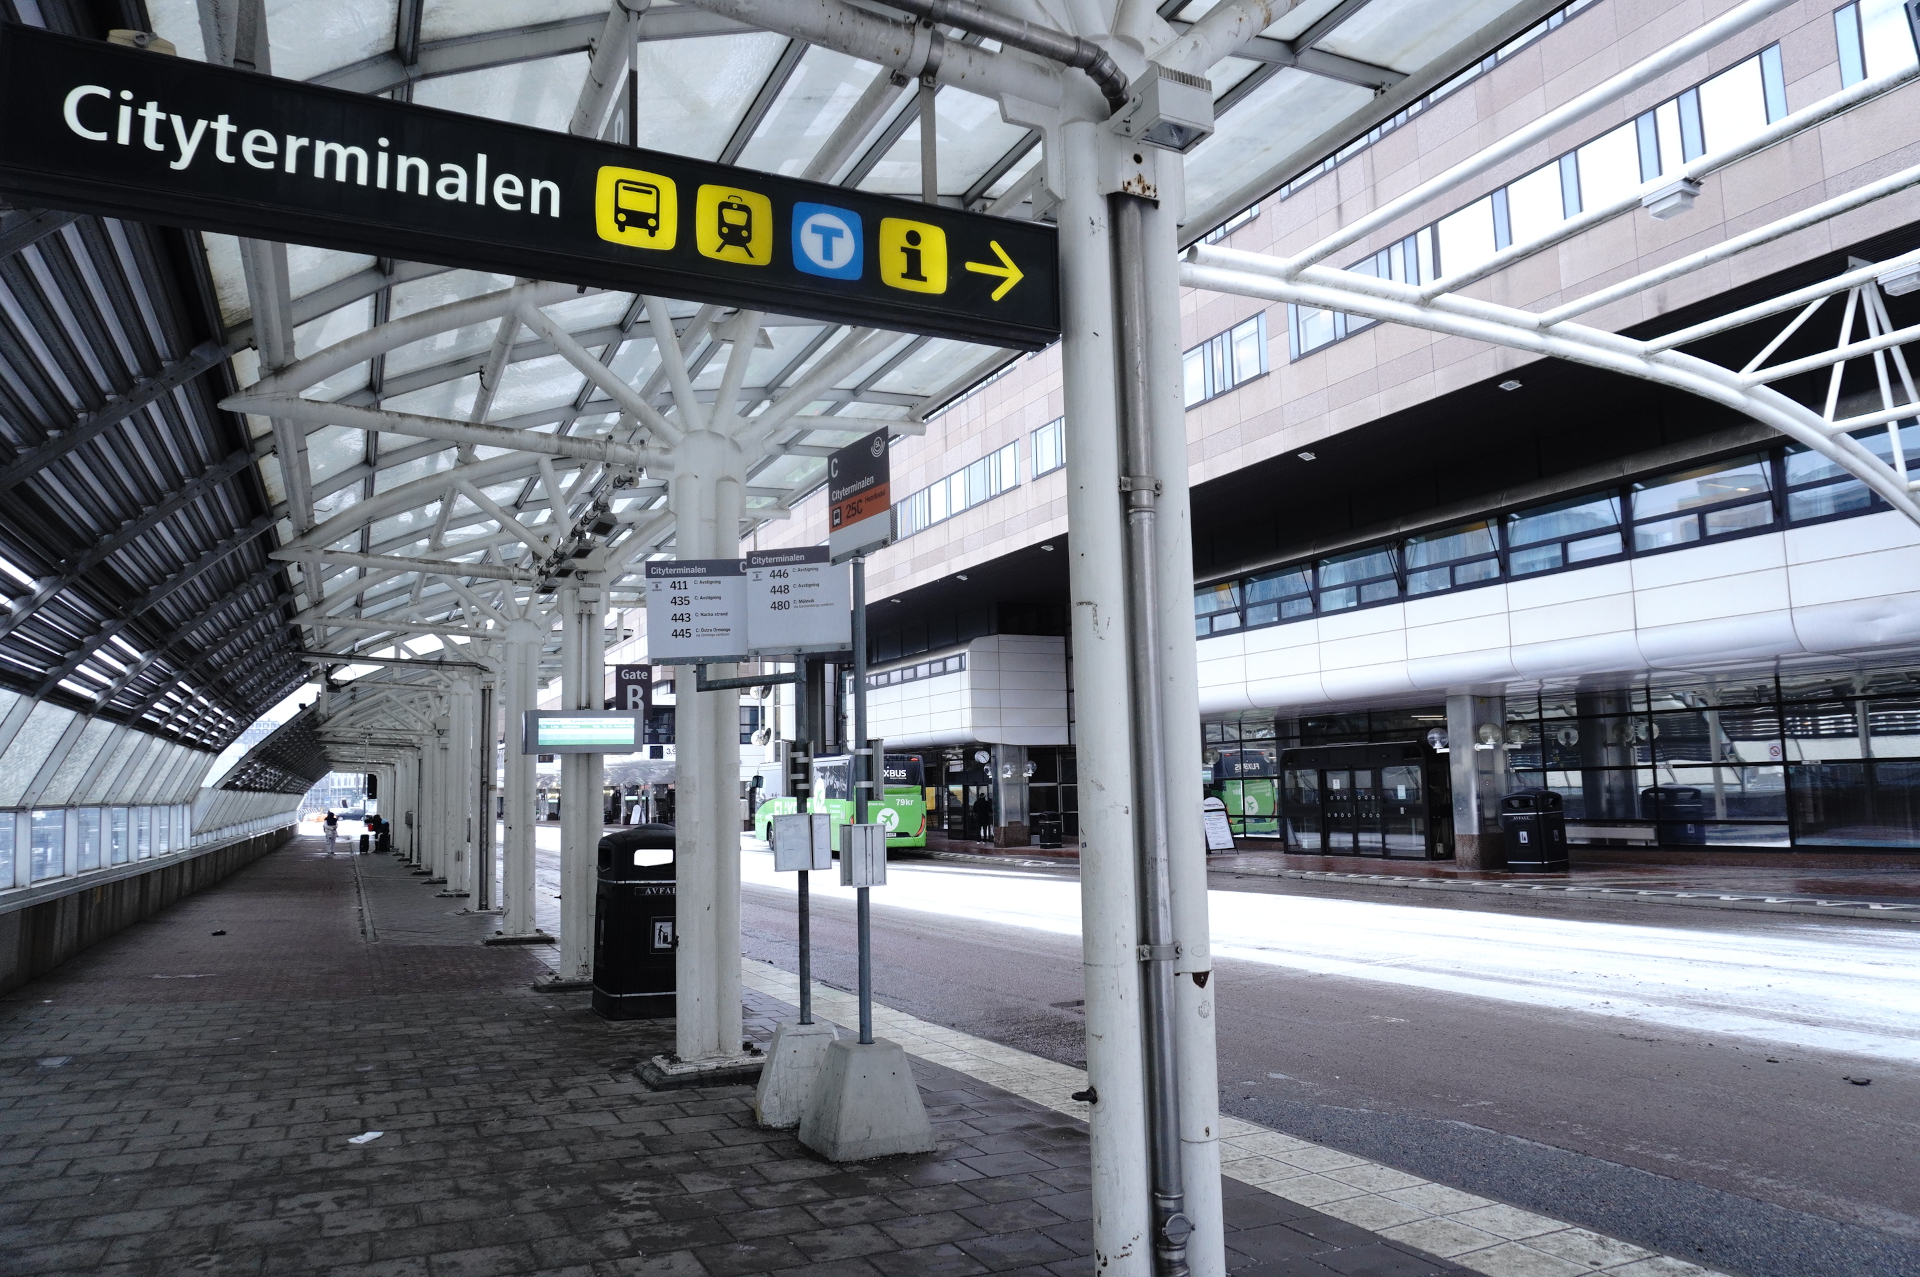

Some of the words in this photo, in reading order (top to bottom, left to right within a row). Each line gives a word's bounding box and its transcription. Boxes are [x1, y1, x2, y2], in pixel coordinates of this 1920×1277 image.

[62, 84, 561, 218] Cityterminalen
[830, 457, 839, 478] C
[831, 475, 875, 502] Cityterminalen
[845, 499, 863, 519] 25C
[751, 553, 805, 565] Cityterminalen
[650, 566, 707, 576] Cityterminalen
[769, 568, 789, 579] 446
[669, 580, 688, 590] 411
[769, 584, 790, 595] 448
[670, 596, 690, 606] 435
[770, 600, 790, 611] 480
[671, 612, 691, 623] 443
[671, 628, 692, 639] 445
[621, 669, 648, 680] Gate
[626, 684, 645, 710] B
[884, 766, 906, 777] XBUS
[645, 887, 676, 895] AVFAL
